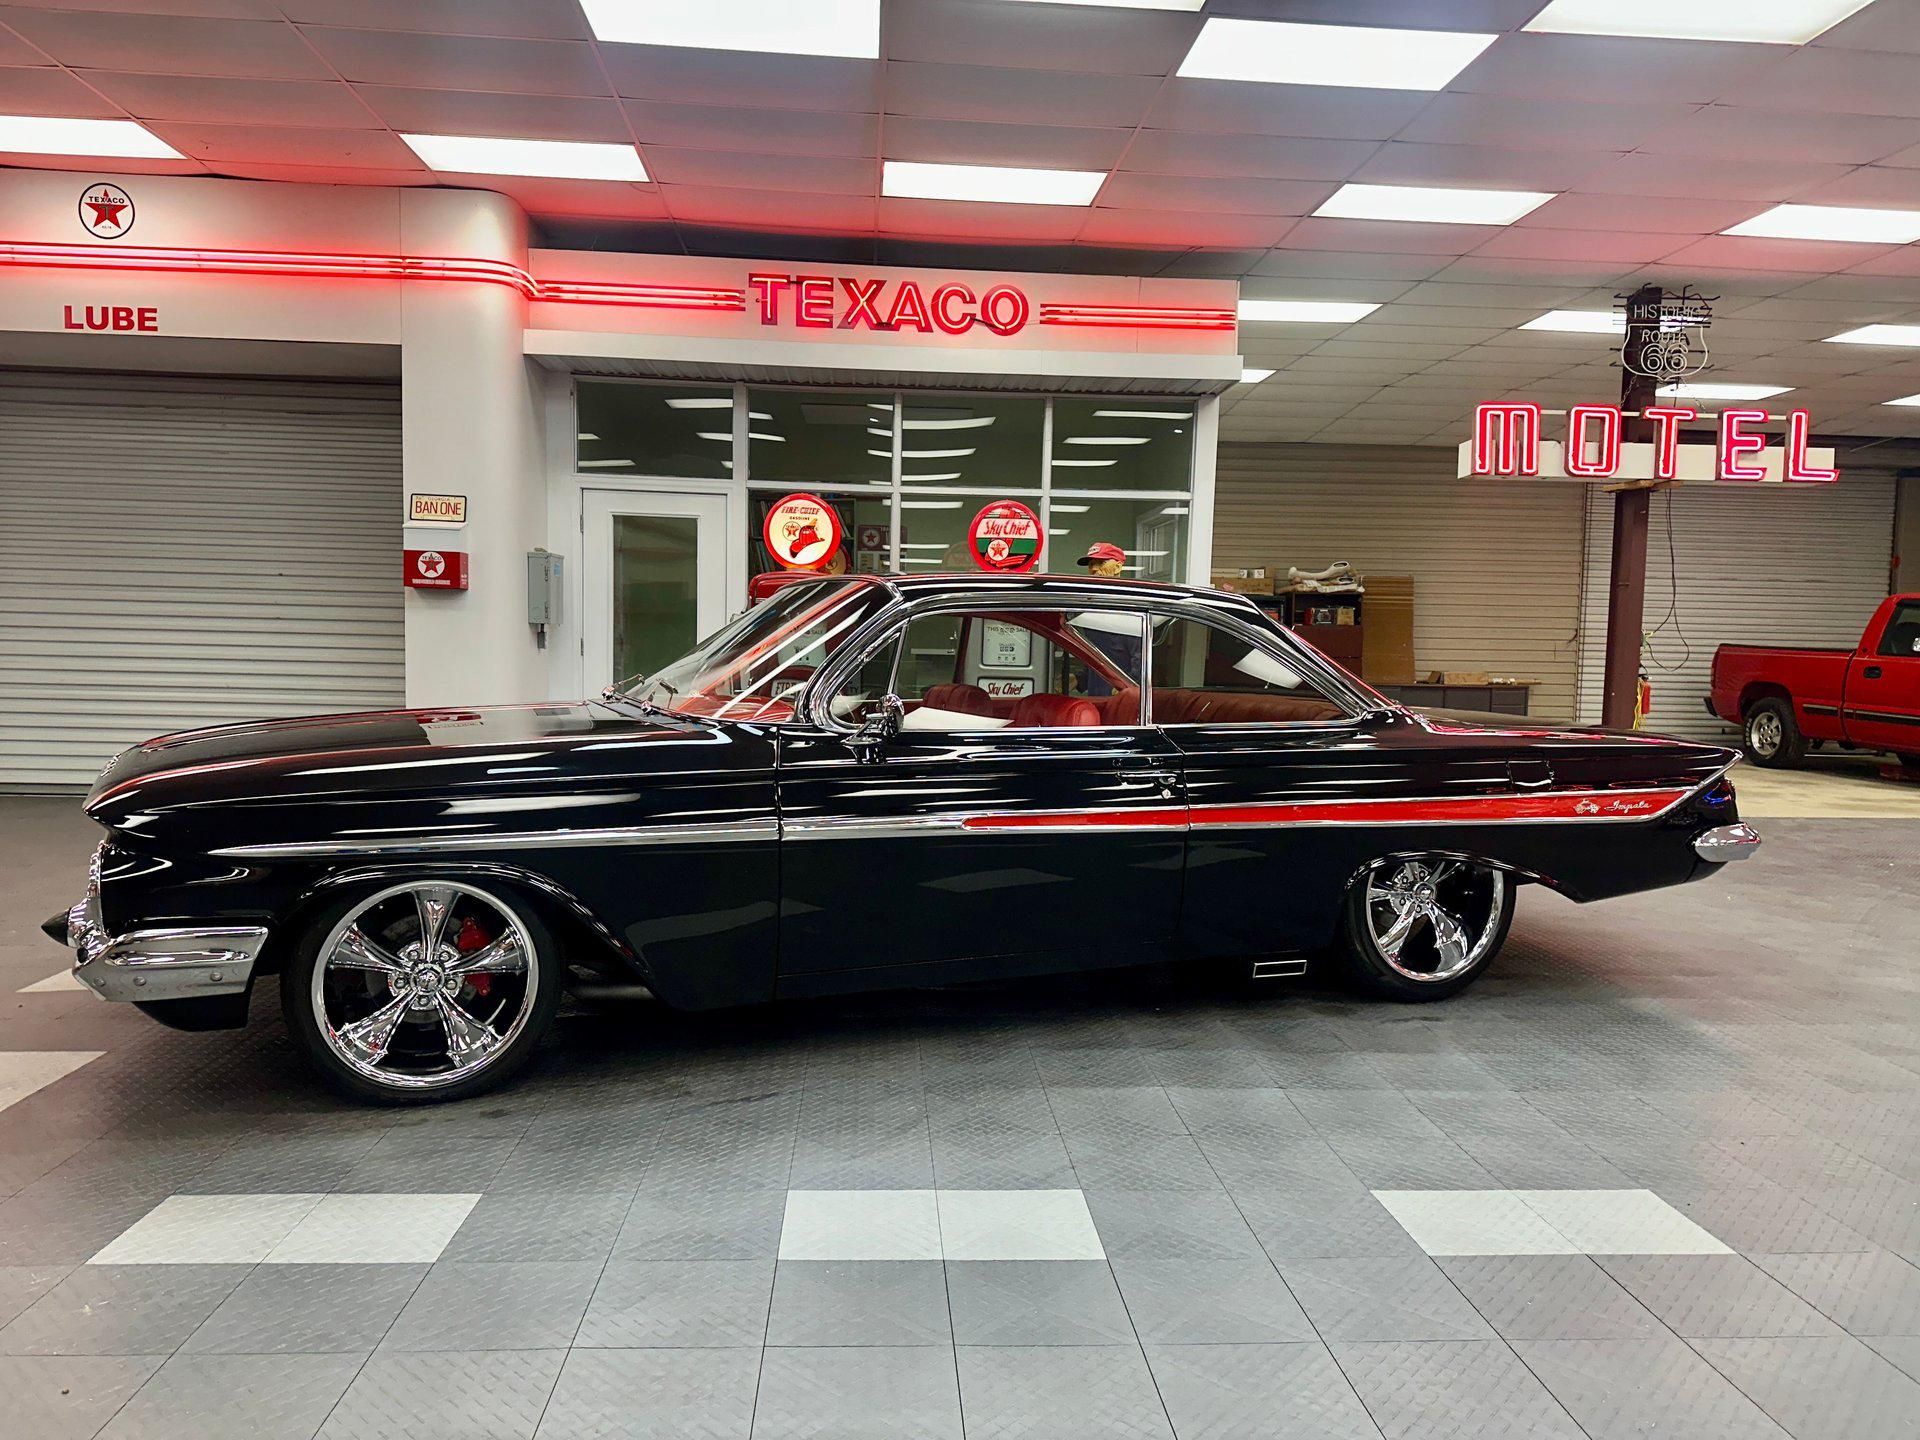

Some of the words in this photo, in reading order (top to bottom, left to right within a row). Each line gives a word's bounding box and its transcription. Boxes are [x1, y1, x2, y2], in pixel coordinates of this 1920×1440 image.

[88, 196, 125, 204] TEXACO
[748, 273, 1030, 337] TEXACO
[1634, 304, 1701, 319] HISTORIC
[64, 305, 159, 332] LUBE
[1641, 329, 1687, 343] ROUTE
[1640, 342, 1688, 373] 66
[1473, 402, 1841, 482] MOTEL
[415, 500, 438, 514] BAN
[440, 501, 462, 516] ONE
[780, 505, 821, 515] FIRE-CHIEF
[983, 520, 1003, 536] Sky
[1003, 519, 1031, 536] Chief
[987, 682, 1002, 696] Sky
[1002, 682, 1025, 696] Chief
[1604, 800, 1653, 814] Impala
